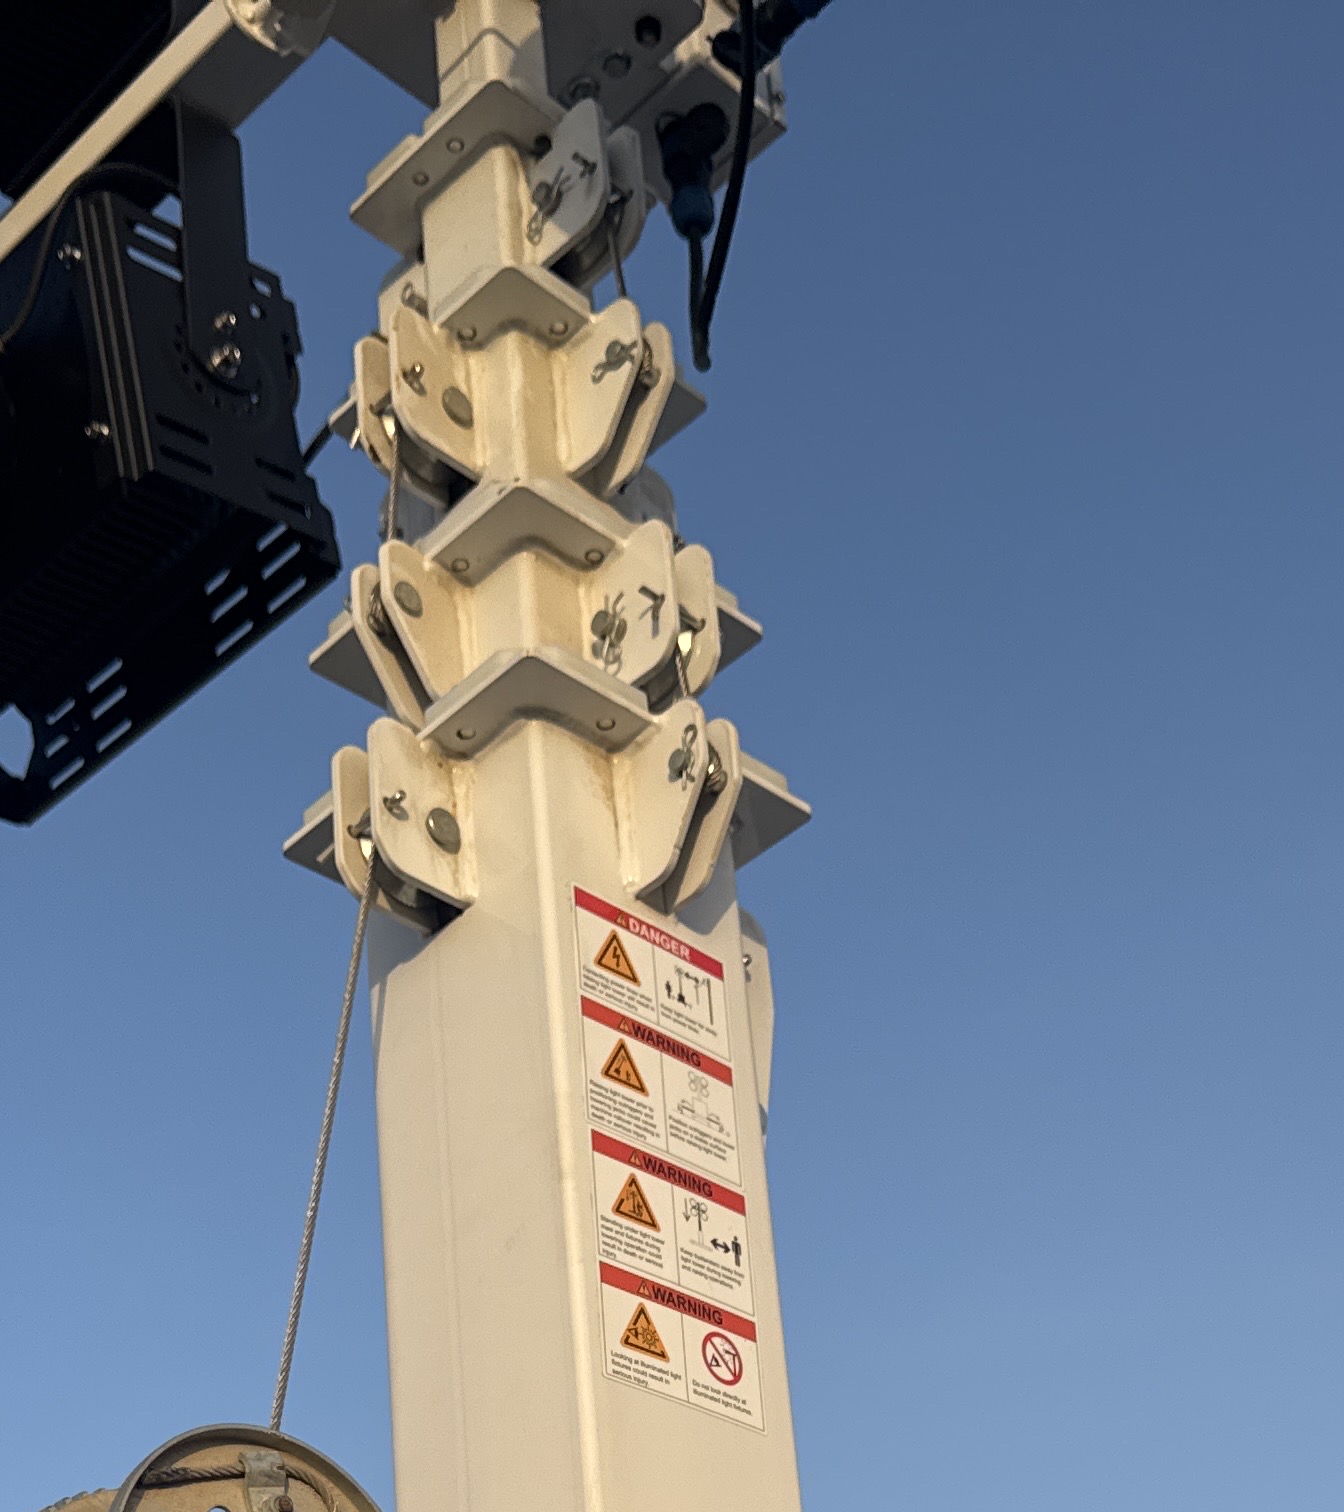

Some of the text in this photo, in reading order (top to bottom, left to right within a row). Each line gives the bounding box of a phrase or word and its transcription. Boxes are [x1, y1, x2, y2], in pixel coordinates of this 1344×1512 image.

[628, 917, 691, 961] DANGER
[631, 1021, 702, 1068] WARNING
[640, 1153, 713, 1198] WARNING
[651, 1286, 723, 1326] WARNING
